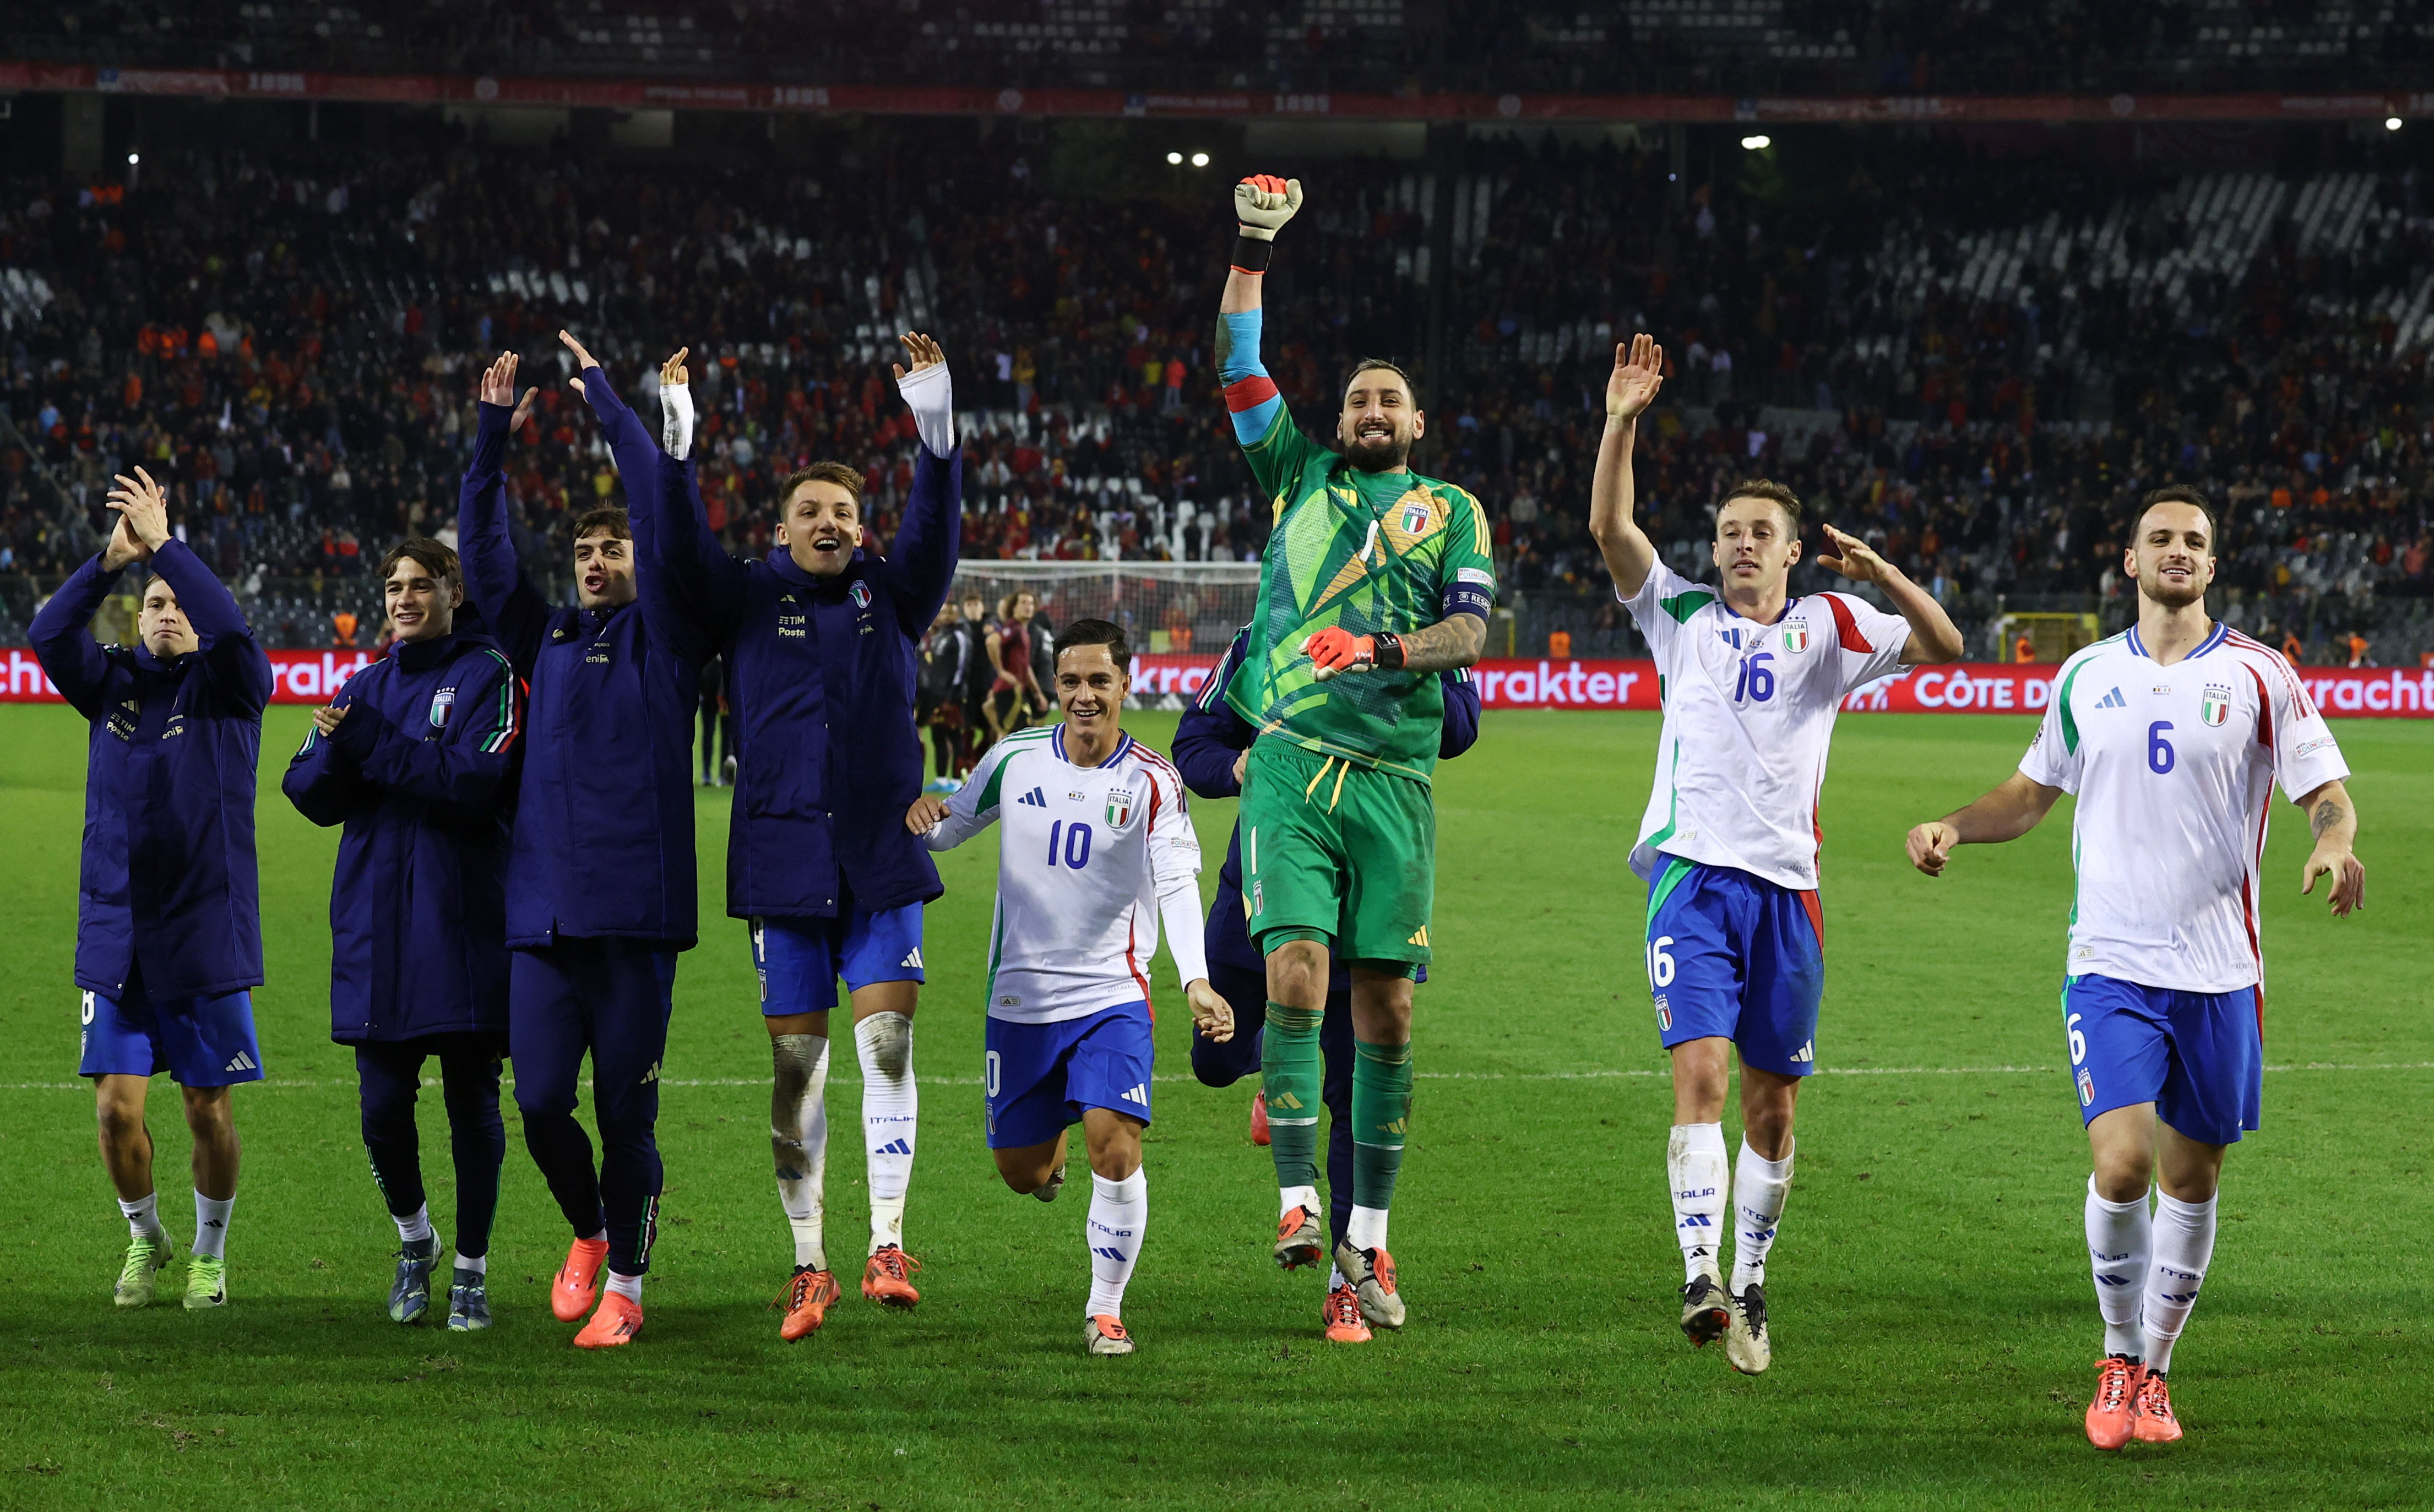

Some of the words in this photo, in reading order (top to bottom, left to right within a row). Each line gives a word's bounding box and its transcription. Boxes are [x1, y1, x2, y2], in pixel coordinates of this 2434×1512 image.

[1406, 508, 1426, 516] ITALIA
[1359, 520, 1379, 562] 1
[790, 616, 806, 625] TIM
[778, 627, 806, 637] Poste
[1473, 661, 1639, 703] rakter
[1734, 652, 1774, 702] 16
[1914, 669, 2015, 708] CÔTE
[2206, 692, 2227, 701] ITALIA
[106, 721, 130, 741] Poste
[121, 720, 136, 733] TIM
[2148, 721, 2175, 774] 6
[2297, 738, 2334, 755] FOUNDATION
[1110, 796, 1129, 804] ITALIA
[1048, 819, 1092, 869] 10
[1646, 936, 1675, 992] 16
[2067, 1013, 2087, 1066] 6
[986, 1050, 1001, 1098] 0
[1674, 1188, 1715, 1199] ITALIA
[1743, 1205, 1780, 1223] ITALI
[1088, 1217, 1132, 1237] ITALIA
